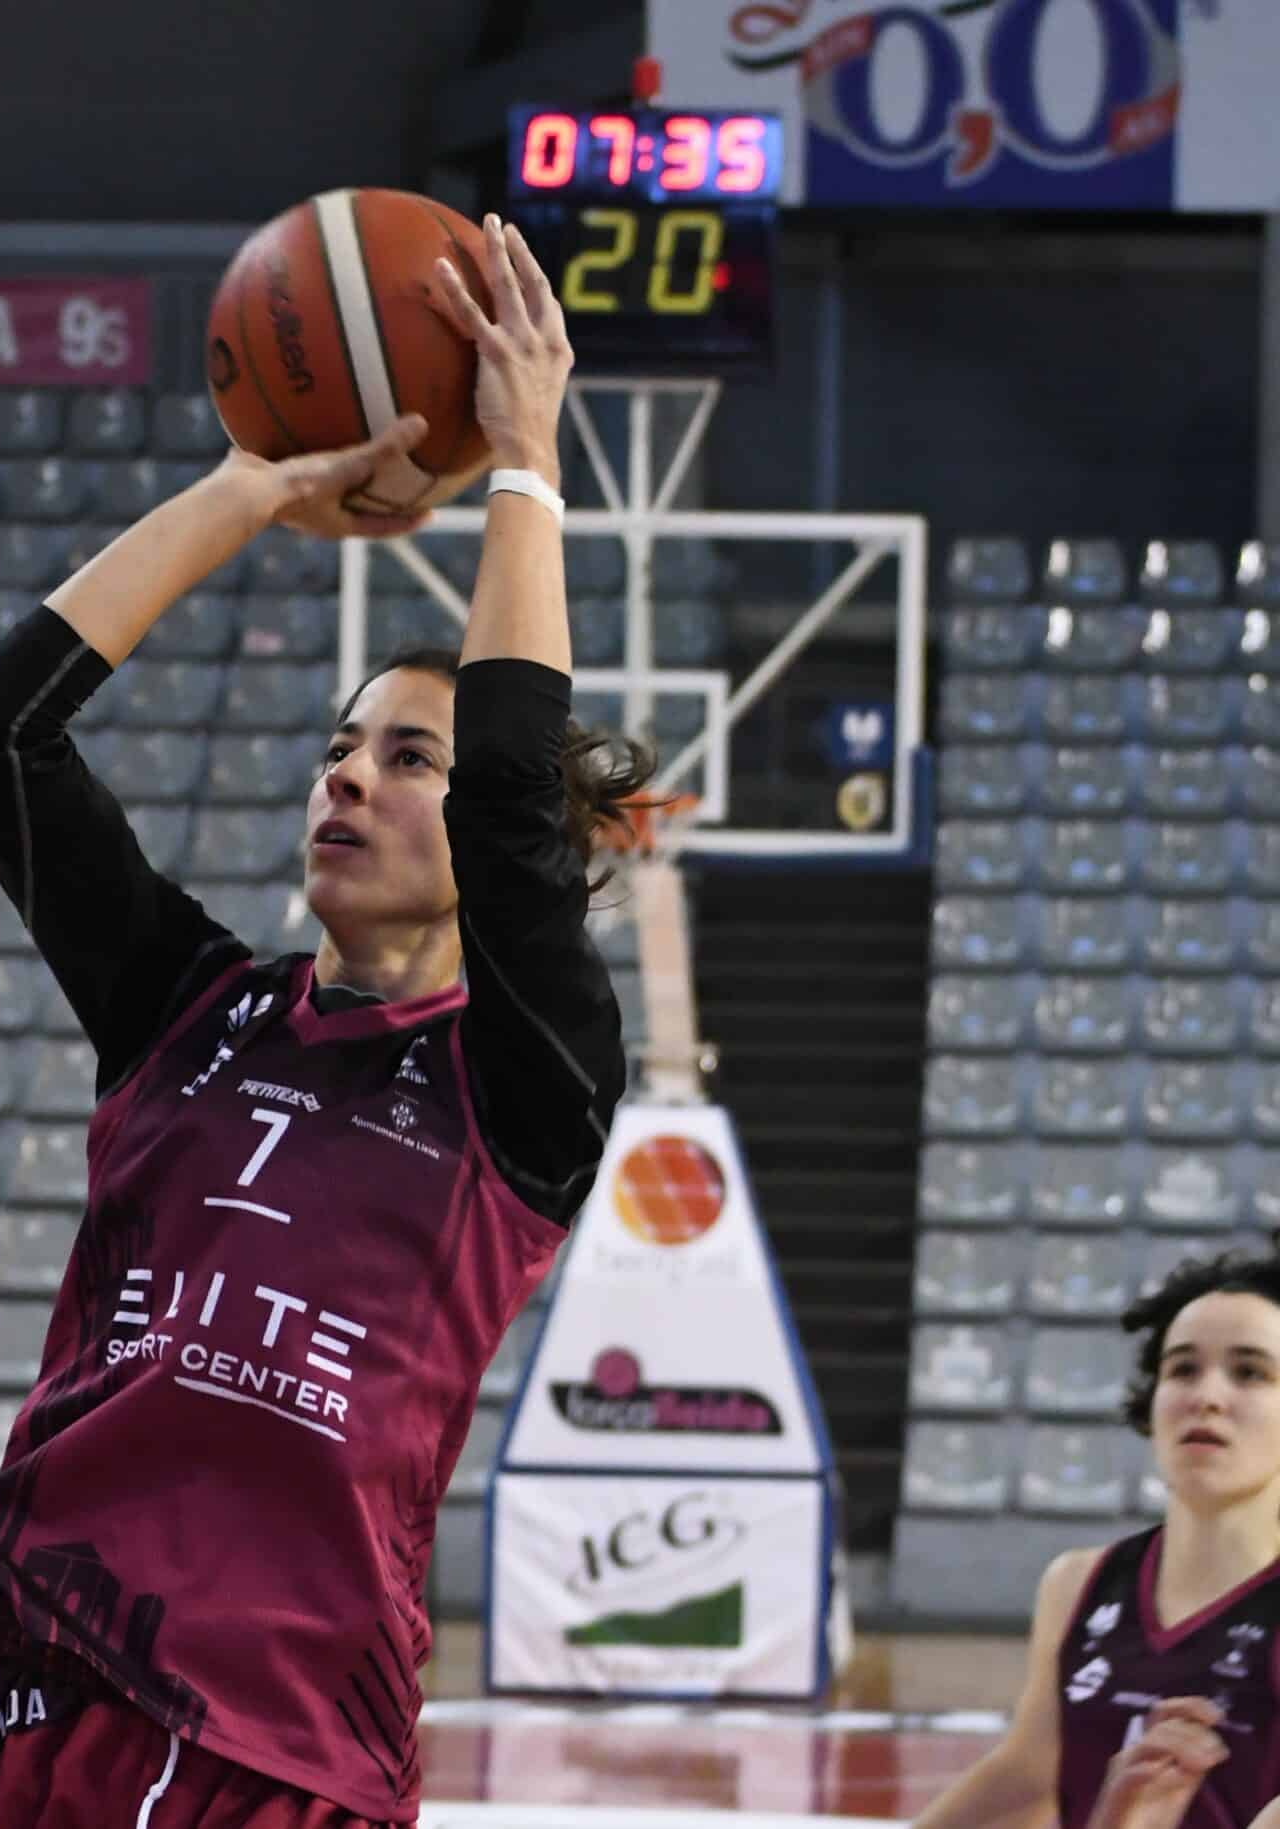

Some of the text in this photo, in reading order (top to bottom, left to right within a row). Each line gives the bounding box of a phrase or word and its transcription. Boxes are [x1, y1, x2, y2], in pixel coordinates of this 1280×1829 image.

[521, 113, 767, 192] 07:35
[562, 208, 722, 315] 20
[237, 1107, 291, 1187] 7
[180, 1343, 350, 1423] CENTER
[580, 1491, 717, 1583] ICG
